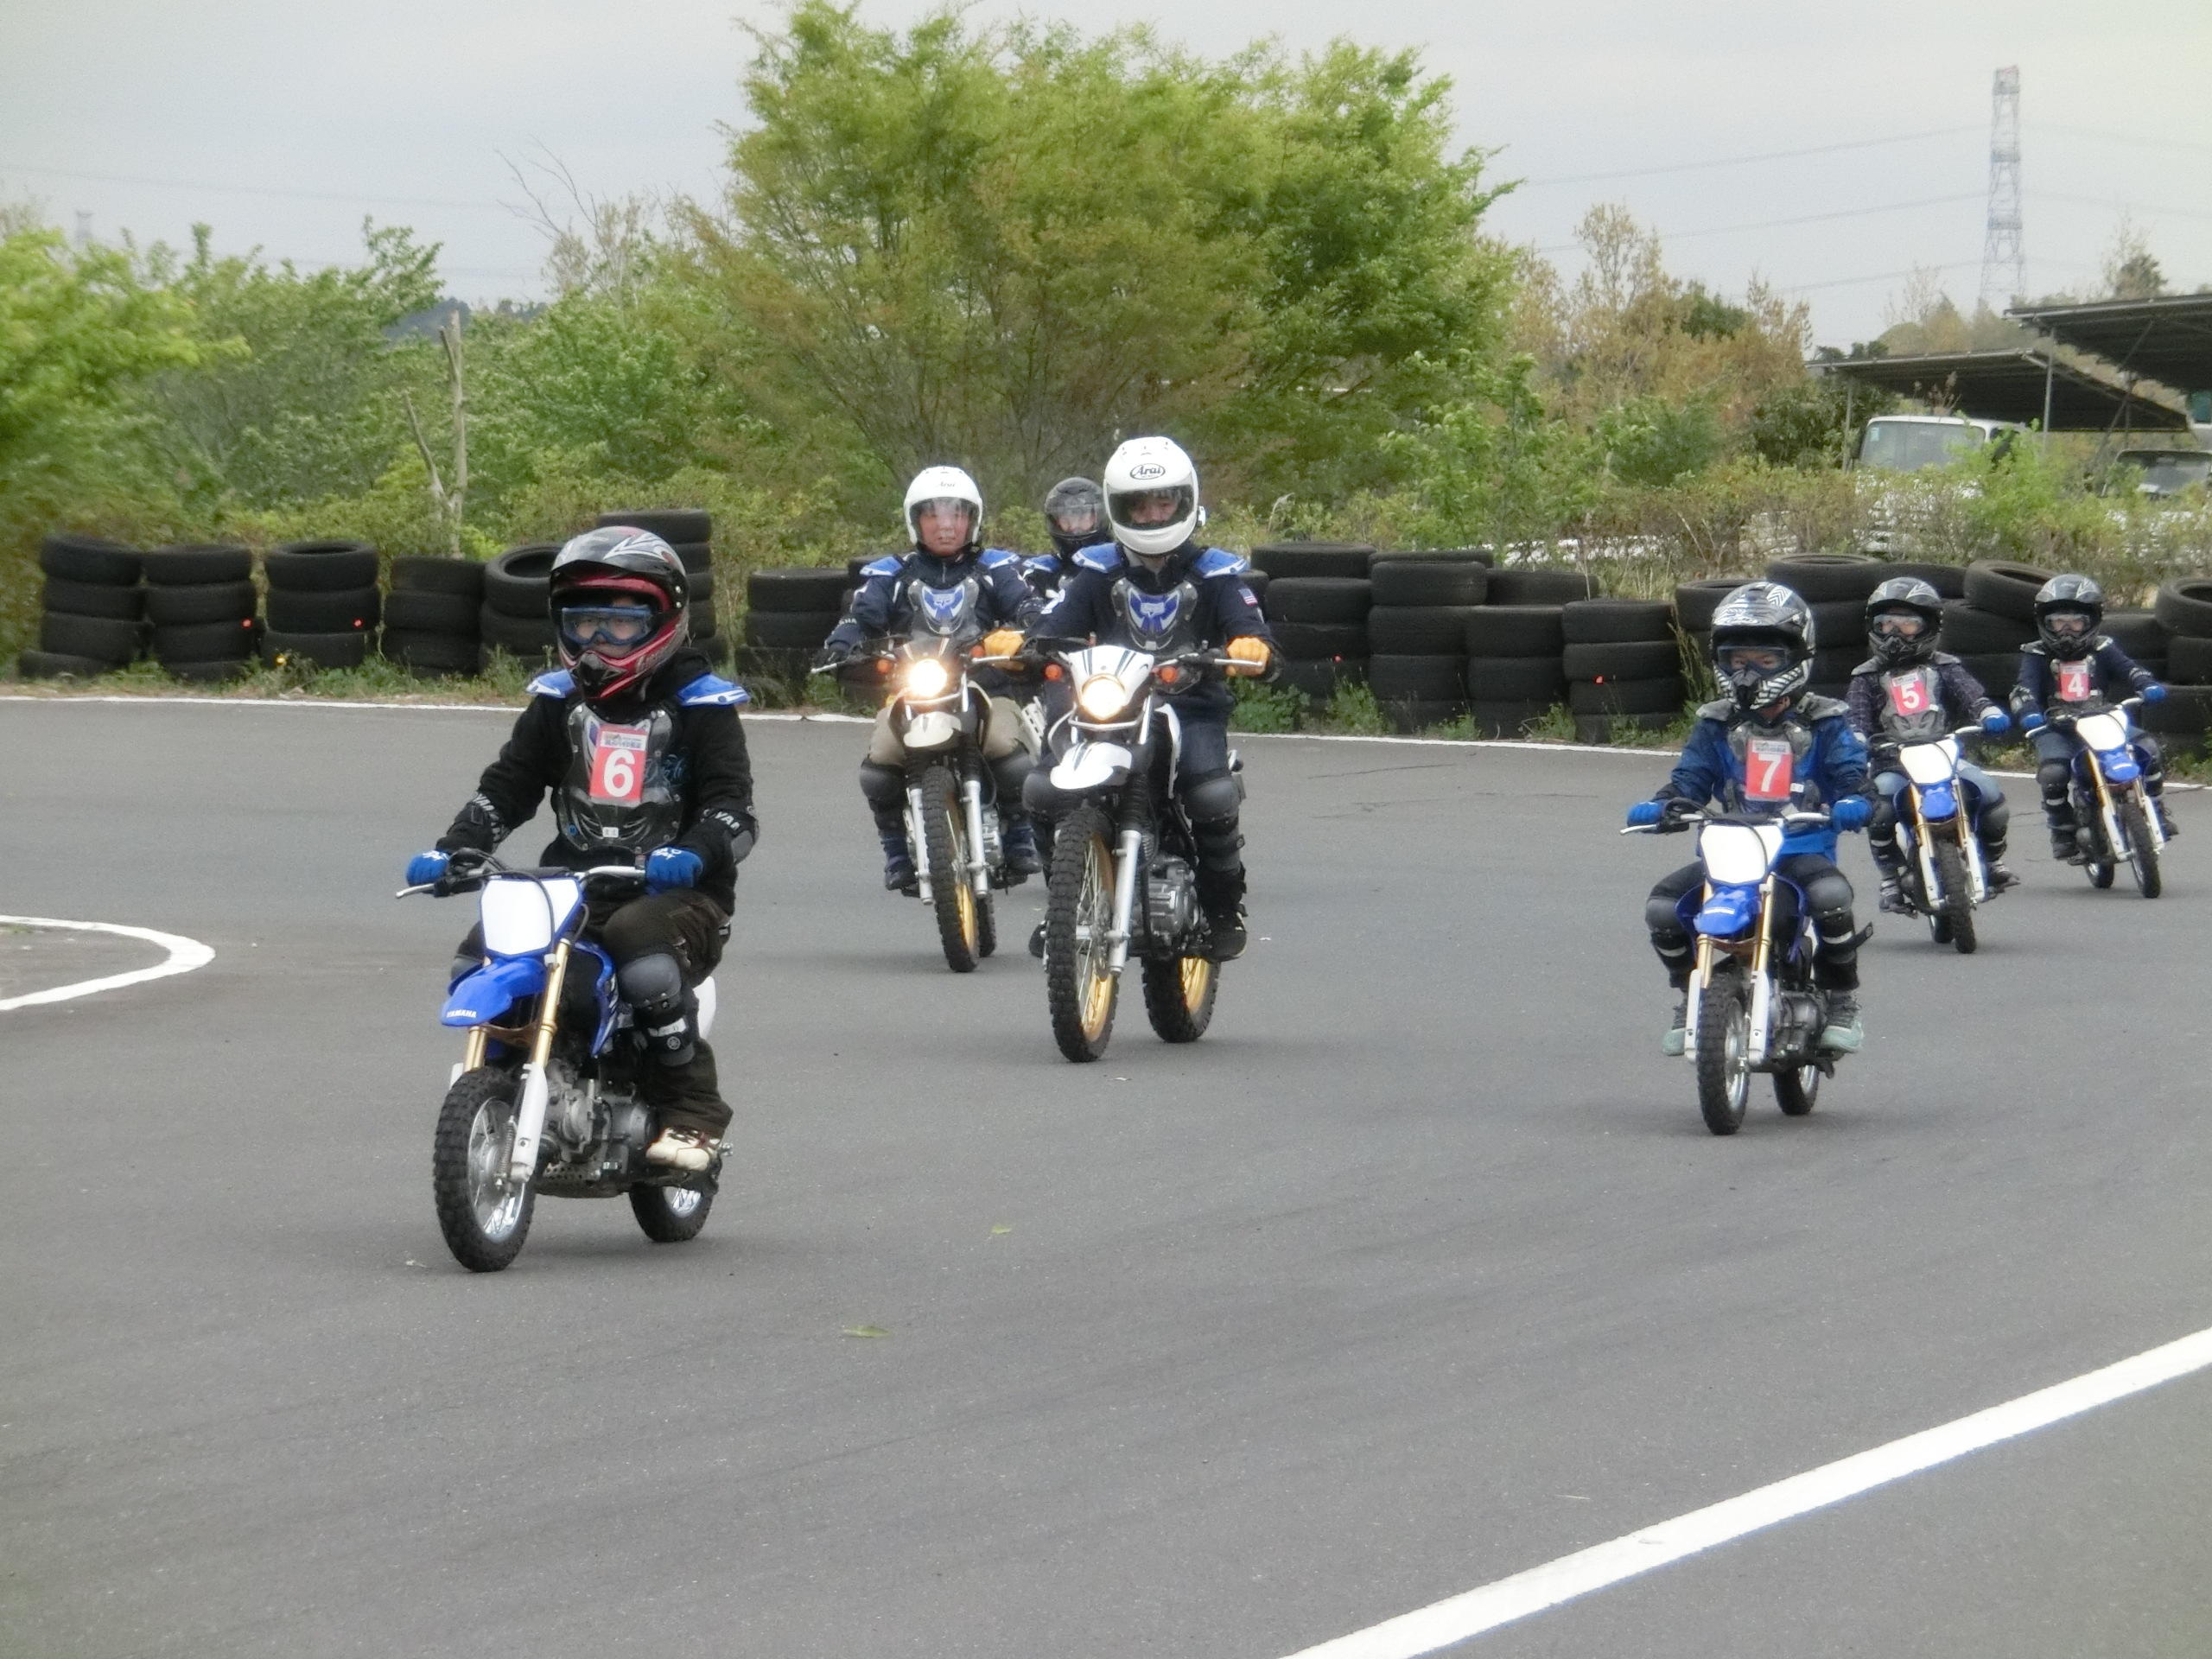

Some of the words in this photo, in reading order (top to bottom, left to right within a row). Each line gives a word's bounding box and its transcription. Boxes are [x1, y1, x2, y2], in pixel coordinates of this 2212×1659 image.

[1133, 465, 1161, 476] Arai
[1901, 683, 1920, 709] 5
[2068, 672, 2083, 697] 4
[604, 749, 635, 798] 6
[1758, 753, 1783, 792] 7
[446, 1009, 477, 1018] YAMAHA
